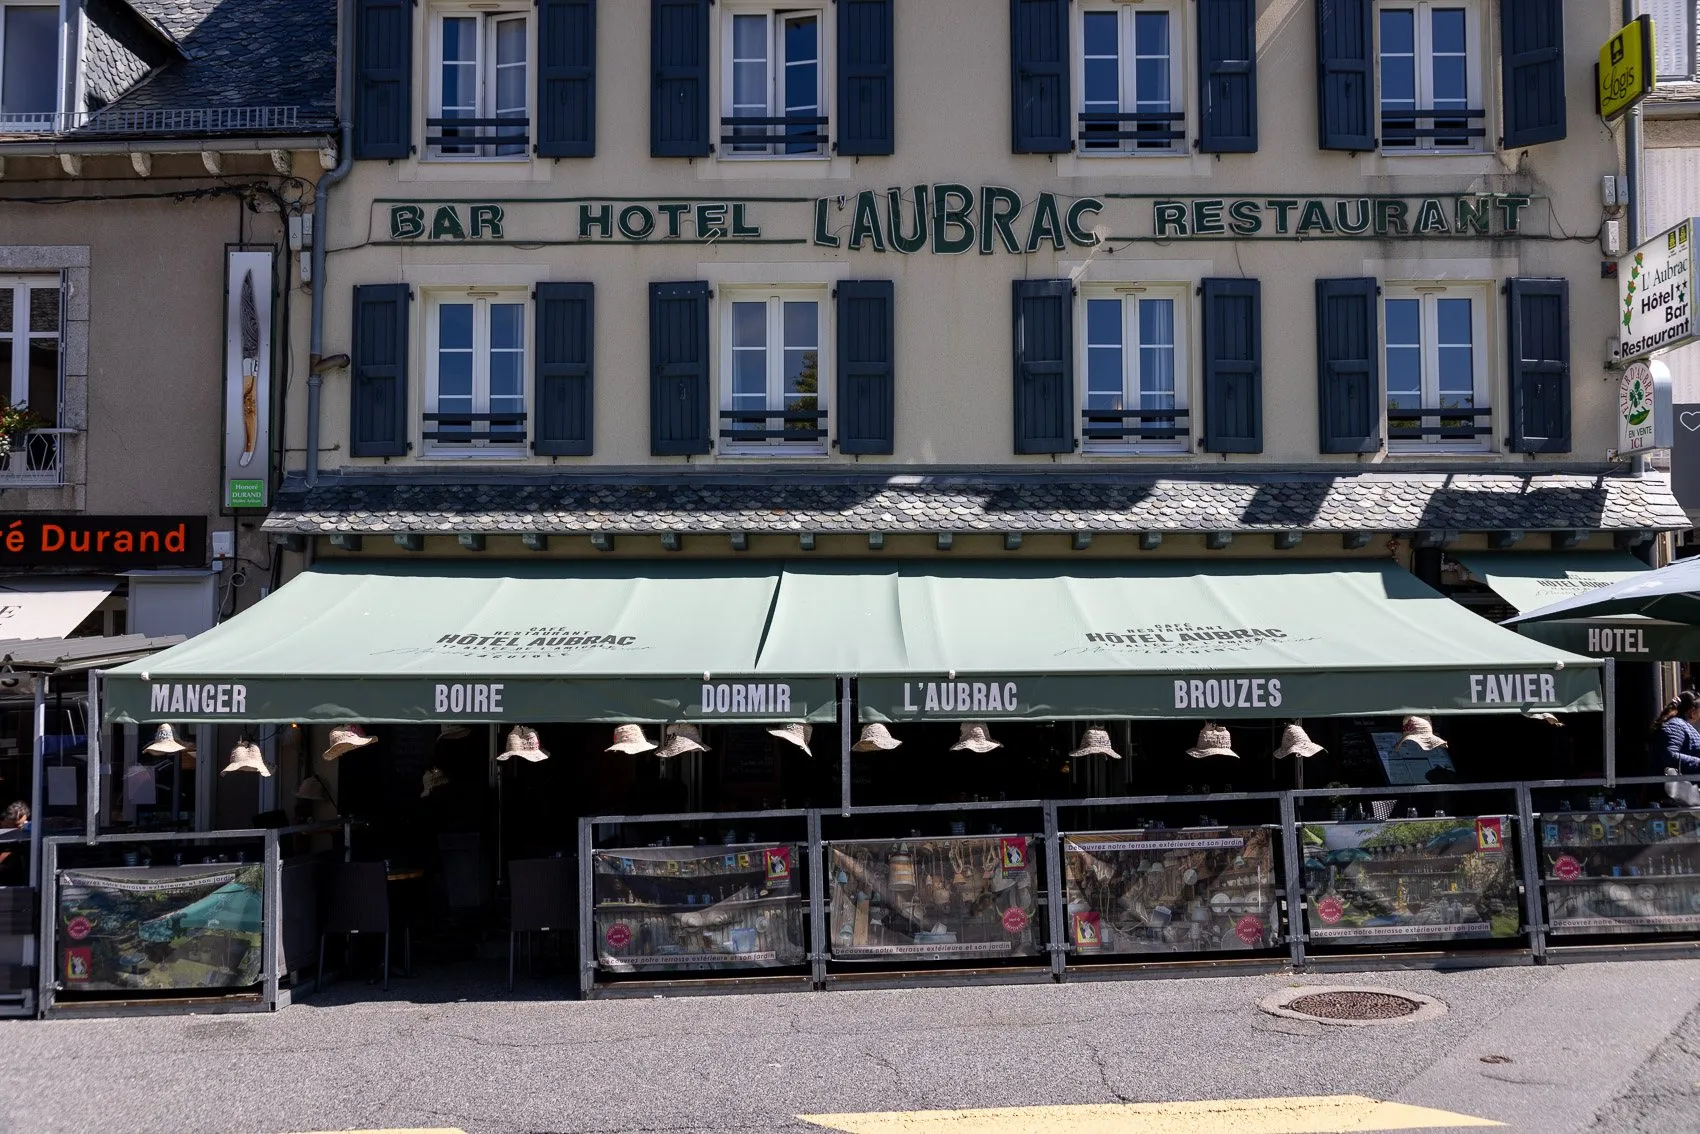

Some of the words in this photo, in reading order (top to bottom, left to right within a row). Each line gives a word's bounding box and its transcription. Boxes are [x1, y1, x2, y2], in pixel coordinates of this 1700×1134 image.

[1602, 66, 1635, 107] Logis
[390, 203, 505, 240] BAR
[578, 202, 761, 241] HOTEL
[813, 183, 1105, 256] L'AUBRAC
[1153, 197, 1531, 239] RESTAURANT
[1641, 284, 1674, 314] Hôtel
[1665, 302, 1688, 323] Bar
[1621, 318, 1690, 359] Restaurant
[1628, 430, 1636, 439] EN
[1636, 426, 1653, 436] VENTE
[1631, 437, 1644, 450] ICI
[0, 519, 25, 552] é
[41, 522, 186, 553] Durand
[436, 633, 520, 646] HÔTEL
[526, 634, 636, 646] AUBRAC
[1086, 632, 1174, 643] HÔTEL
[1178, 628, 1287, 642] AUBRAC
[1127, 626, 1222, 634] RESTAURANT
[1588, 628, 1649, 653] HOTEL
[150, 683, 247, 713] MANGER
[434, 683, 505, 713] BOIRE
[702, 683, 791, 713] DORMIR
[904, 682, 1018, 712] L'AUBRAC
[1174, 677, 1283, 709] BROUZES
[1470, 673, 1556, 704] FAVIER
[1221, 839, 1243, 848] jardin
[926, 944, 963, 952] extérieure
[989, 941, 1010, 951] jardin
